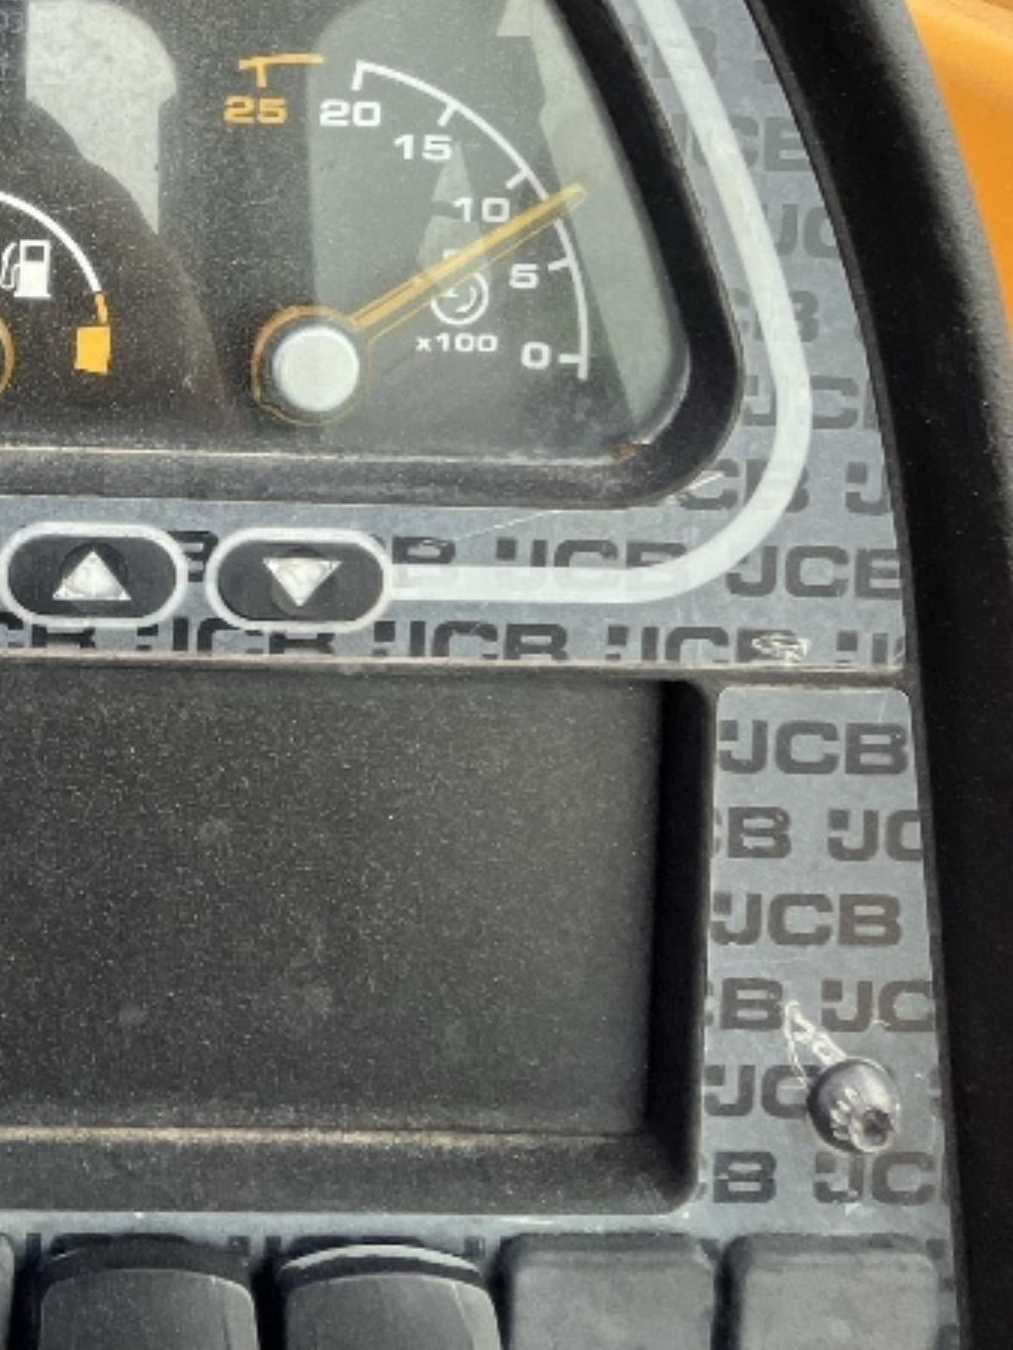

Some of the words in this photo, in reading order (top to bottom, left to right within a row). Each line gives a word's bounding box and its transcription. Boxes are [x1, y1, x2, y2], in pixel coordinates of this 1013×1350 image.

[223, 95, 287, 126] 25
[318, 98, 382, 128] 20
[393, 133, 454, 161] 15
[452, 196, 511, 224] 10
[508, 262, 540, 290] 5
[415, 332, 499, 354] x100
[519, 341, 551, 370] 0
[717, 718, 909, 776] JCB
[826, 809, 922, 862] JC
[709, 892, 903, 947] JCB
[820, 980, 935, 1033] JC
[703, 1064, 823, 1119] JC
[812, 1152, 937, 1204] JC
